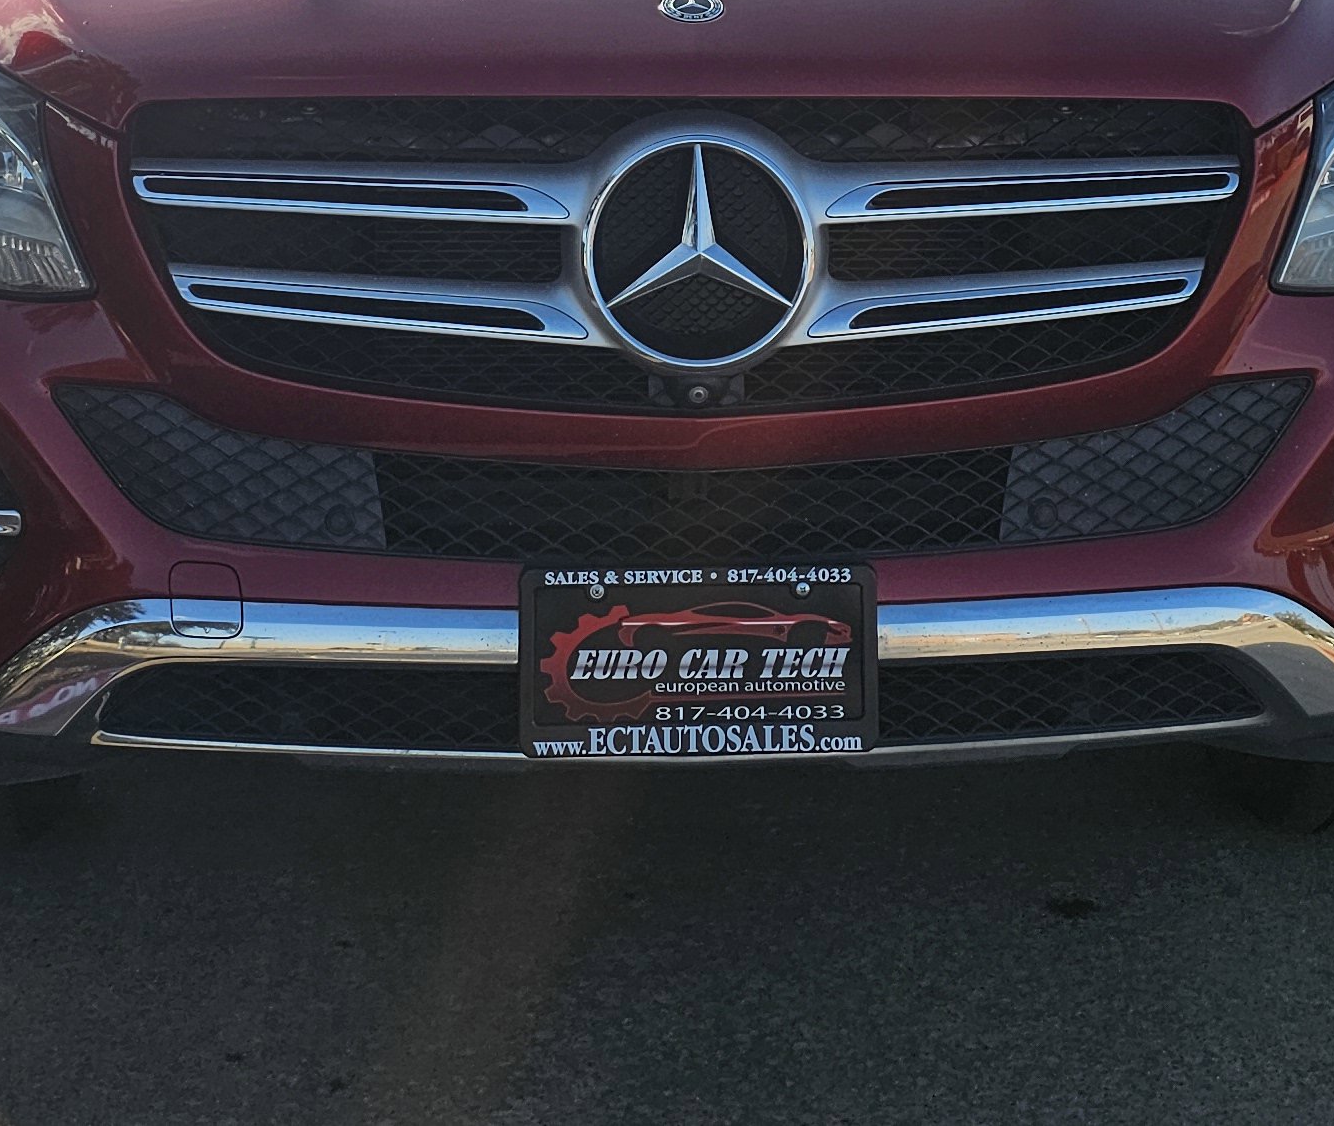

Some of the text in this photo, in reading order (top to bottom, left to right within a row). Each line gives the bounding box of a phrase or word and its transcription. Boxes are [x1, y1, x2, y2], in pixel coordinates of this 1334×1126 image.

[544, 568, 852, 586] SALES & SERVICE 817-404-4033
[569, 647, 851, 680] EURO CAR TECH
[655, 678, 846, 695] european automotive
[655, 705, 845, 721] 817-404-4033
[532, 725, 863, 756] www.ECTAUTOSALES.com
